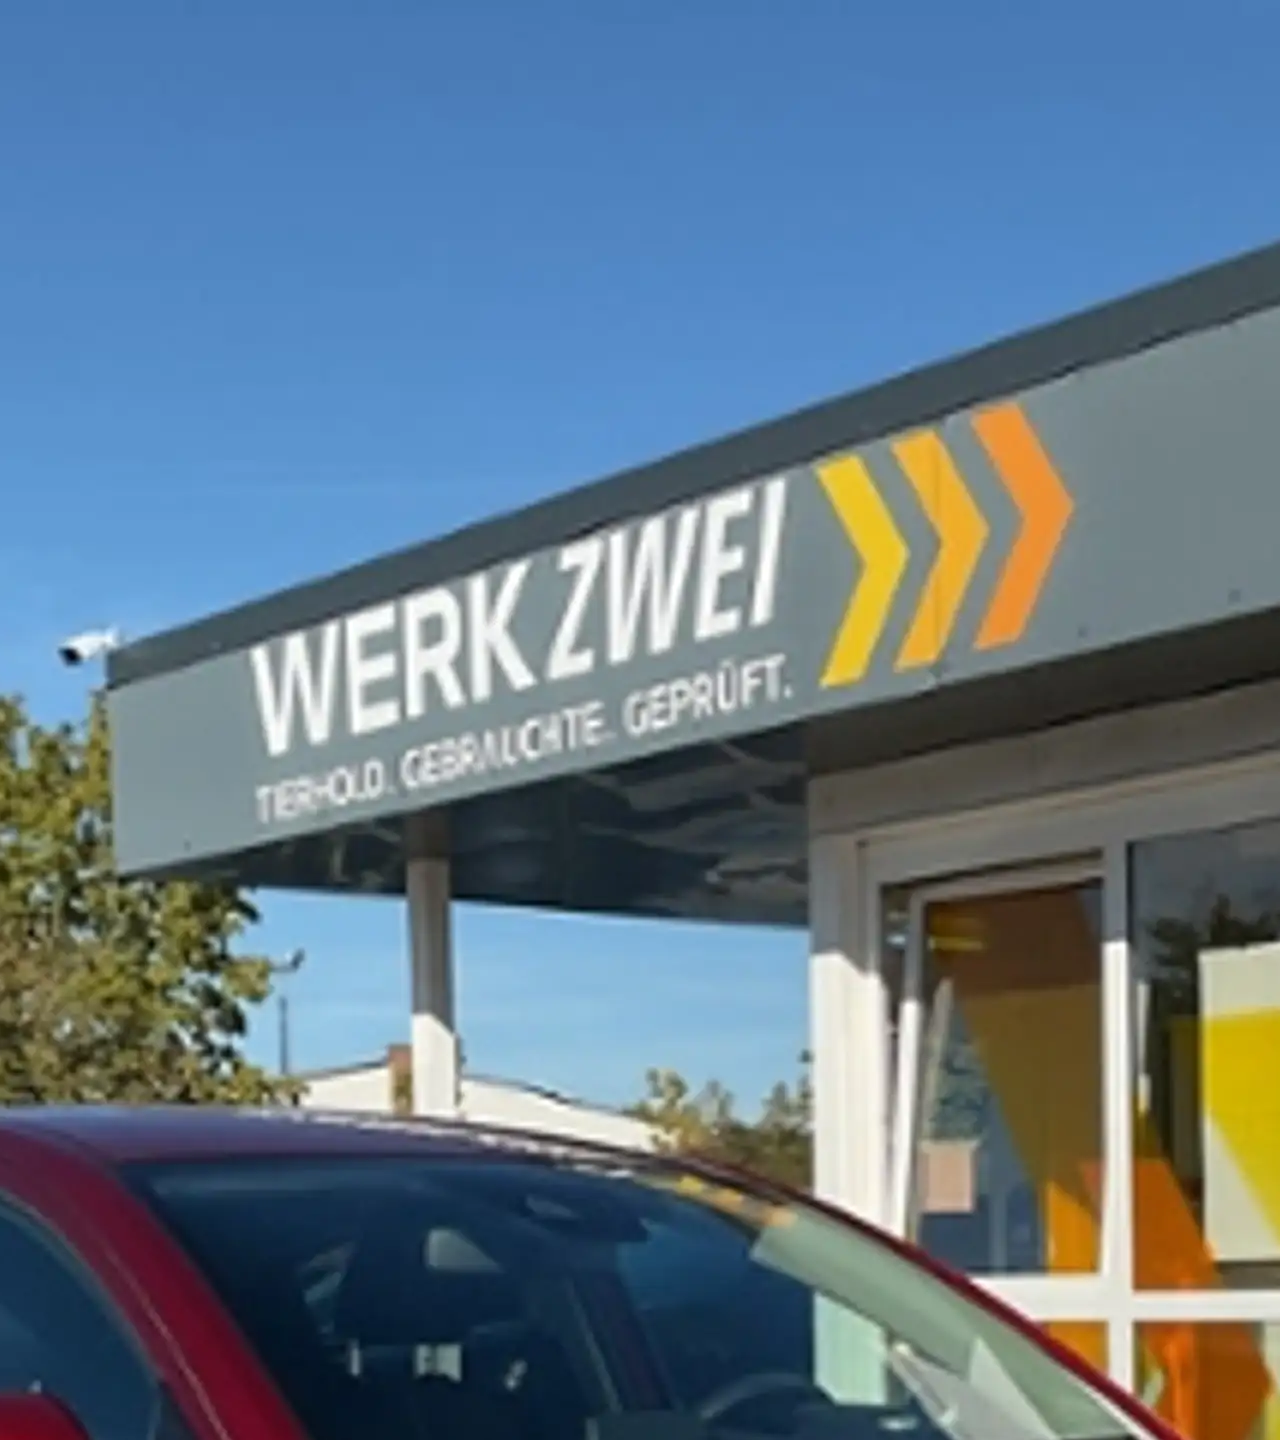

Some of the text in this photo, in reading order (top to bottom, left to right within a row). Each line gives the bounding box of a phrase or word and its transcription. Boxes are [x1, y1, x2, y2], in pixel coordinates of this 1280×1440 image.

[250, 479, 788, 756] WERK ZWEI
[256, 655, 794, 825] TIERHOLD. GEBRAUCHTE. GEPRÜFT.
